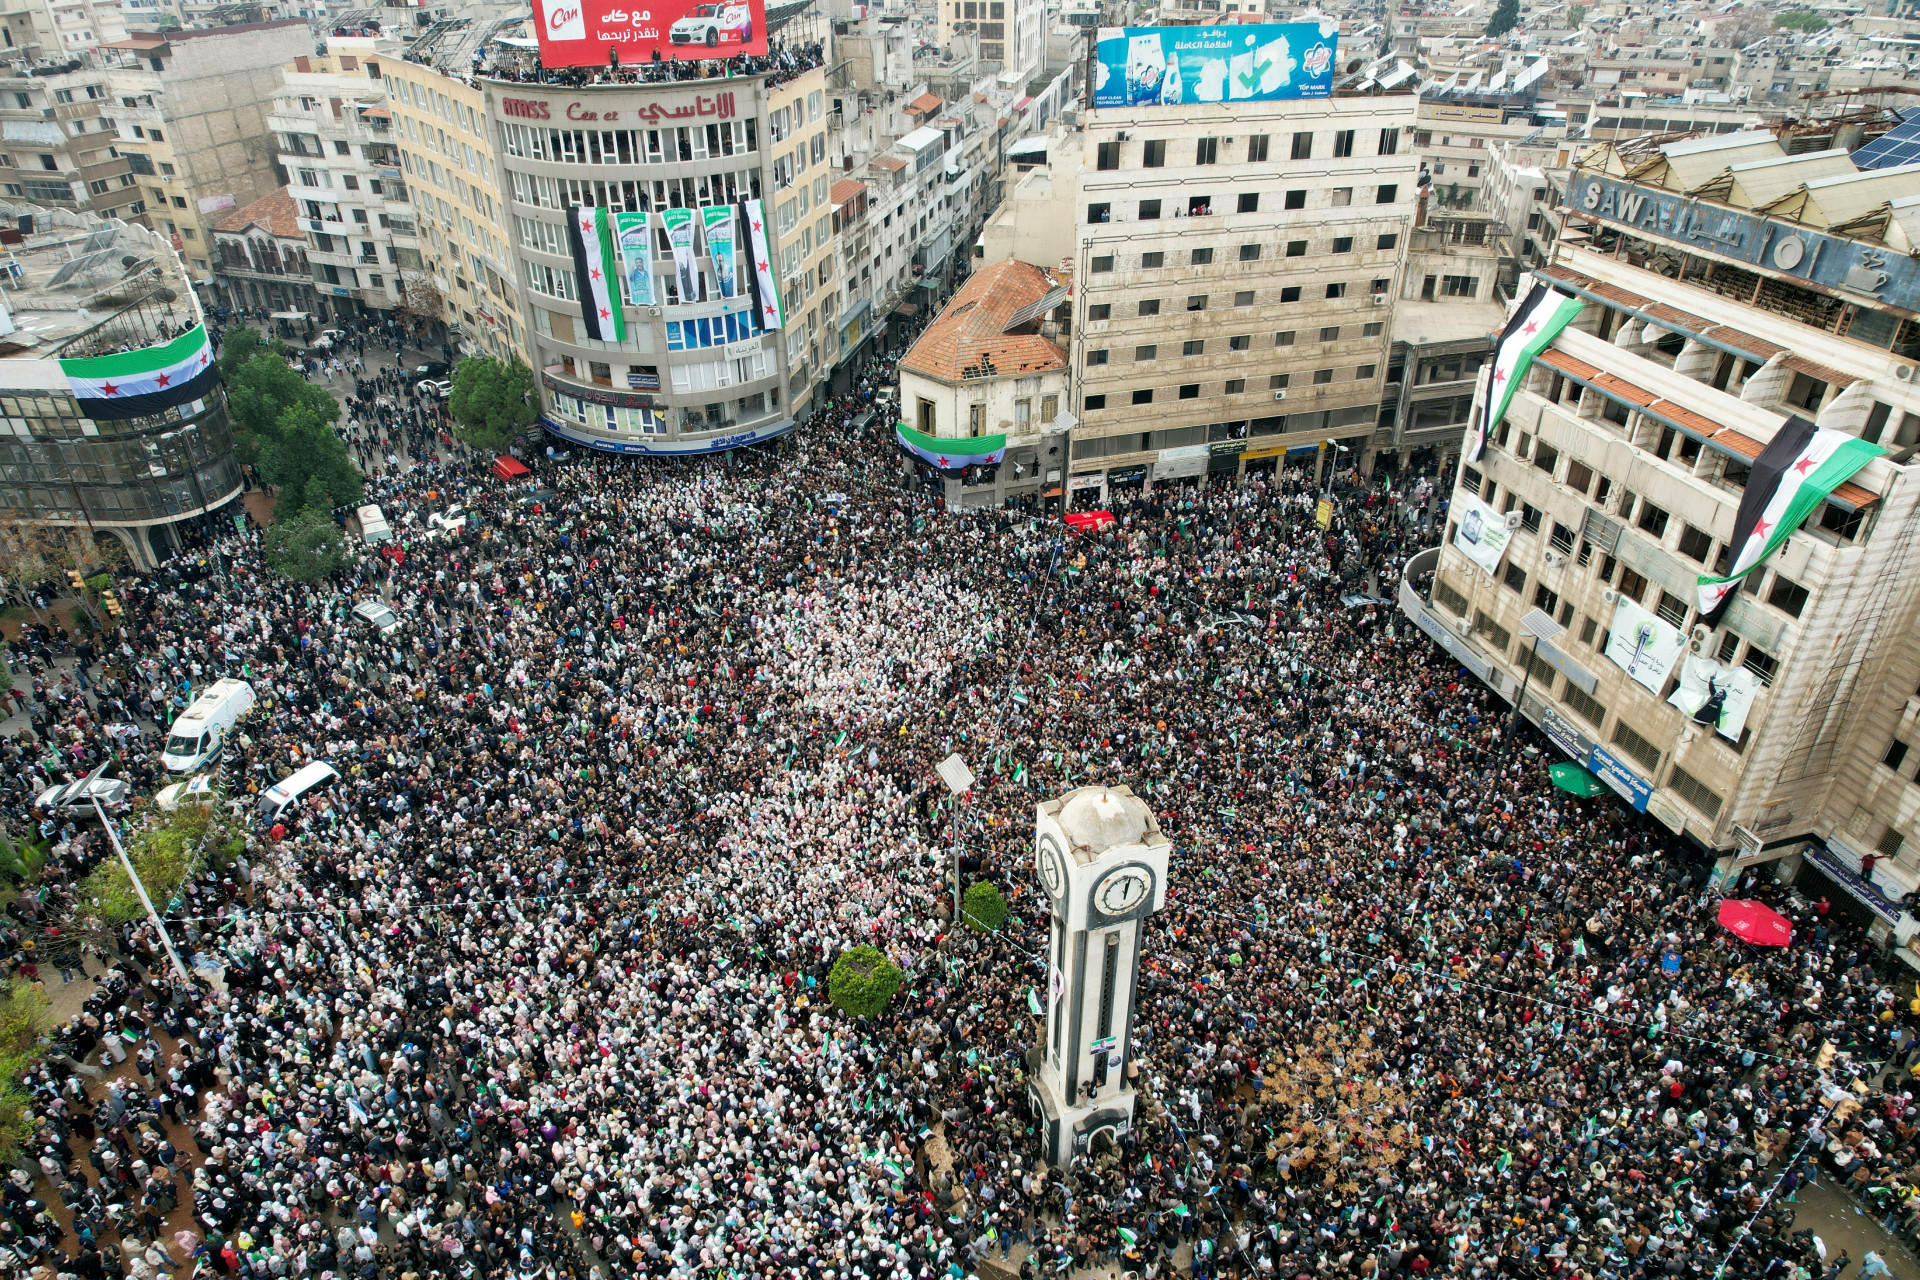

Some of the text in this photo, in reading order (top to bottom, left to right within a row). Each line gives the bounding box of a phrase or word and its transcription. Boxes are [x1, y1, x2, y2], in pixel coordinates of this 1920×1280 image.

[550, 5, 578, 31] Can
[602, 9, 651, 27] مع كان
[597, 27, 659, 43] بتقدر تربحها
[1175, 40, 1233, 50] العلامة الكاملة
